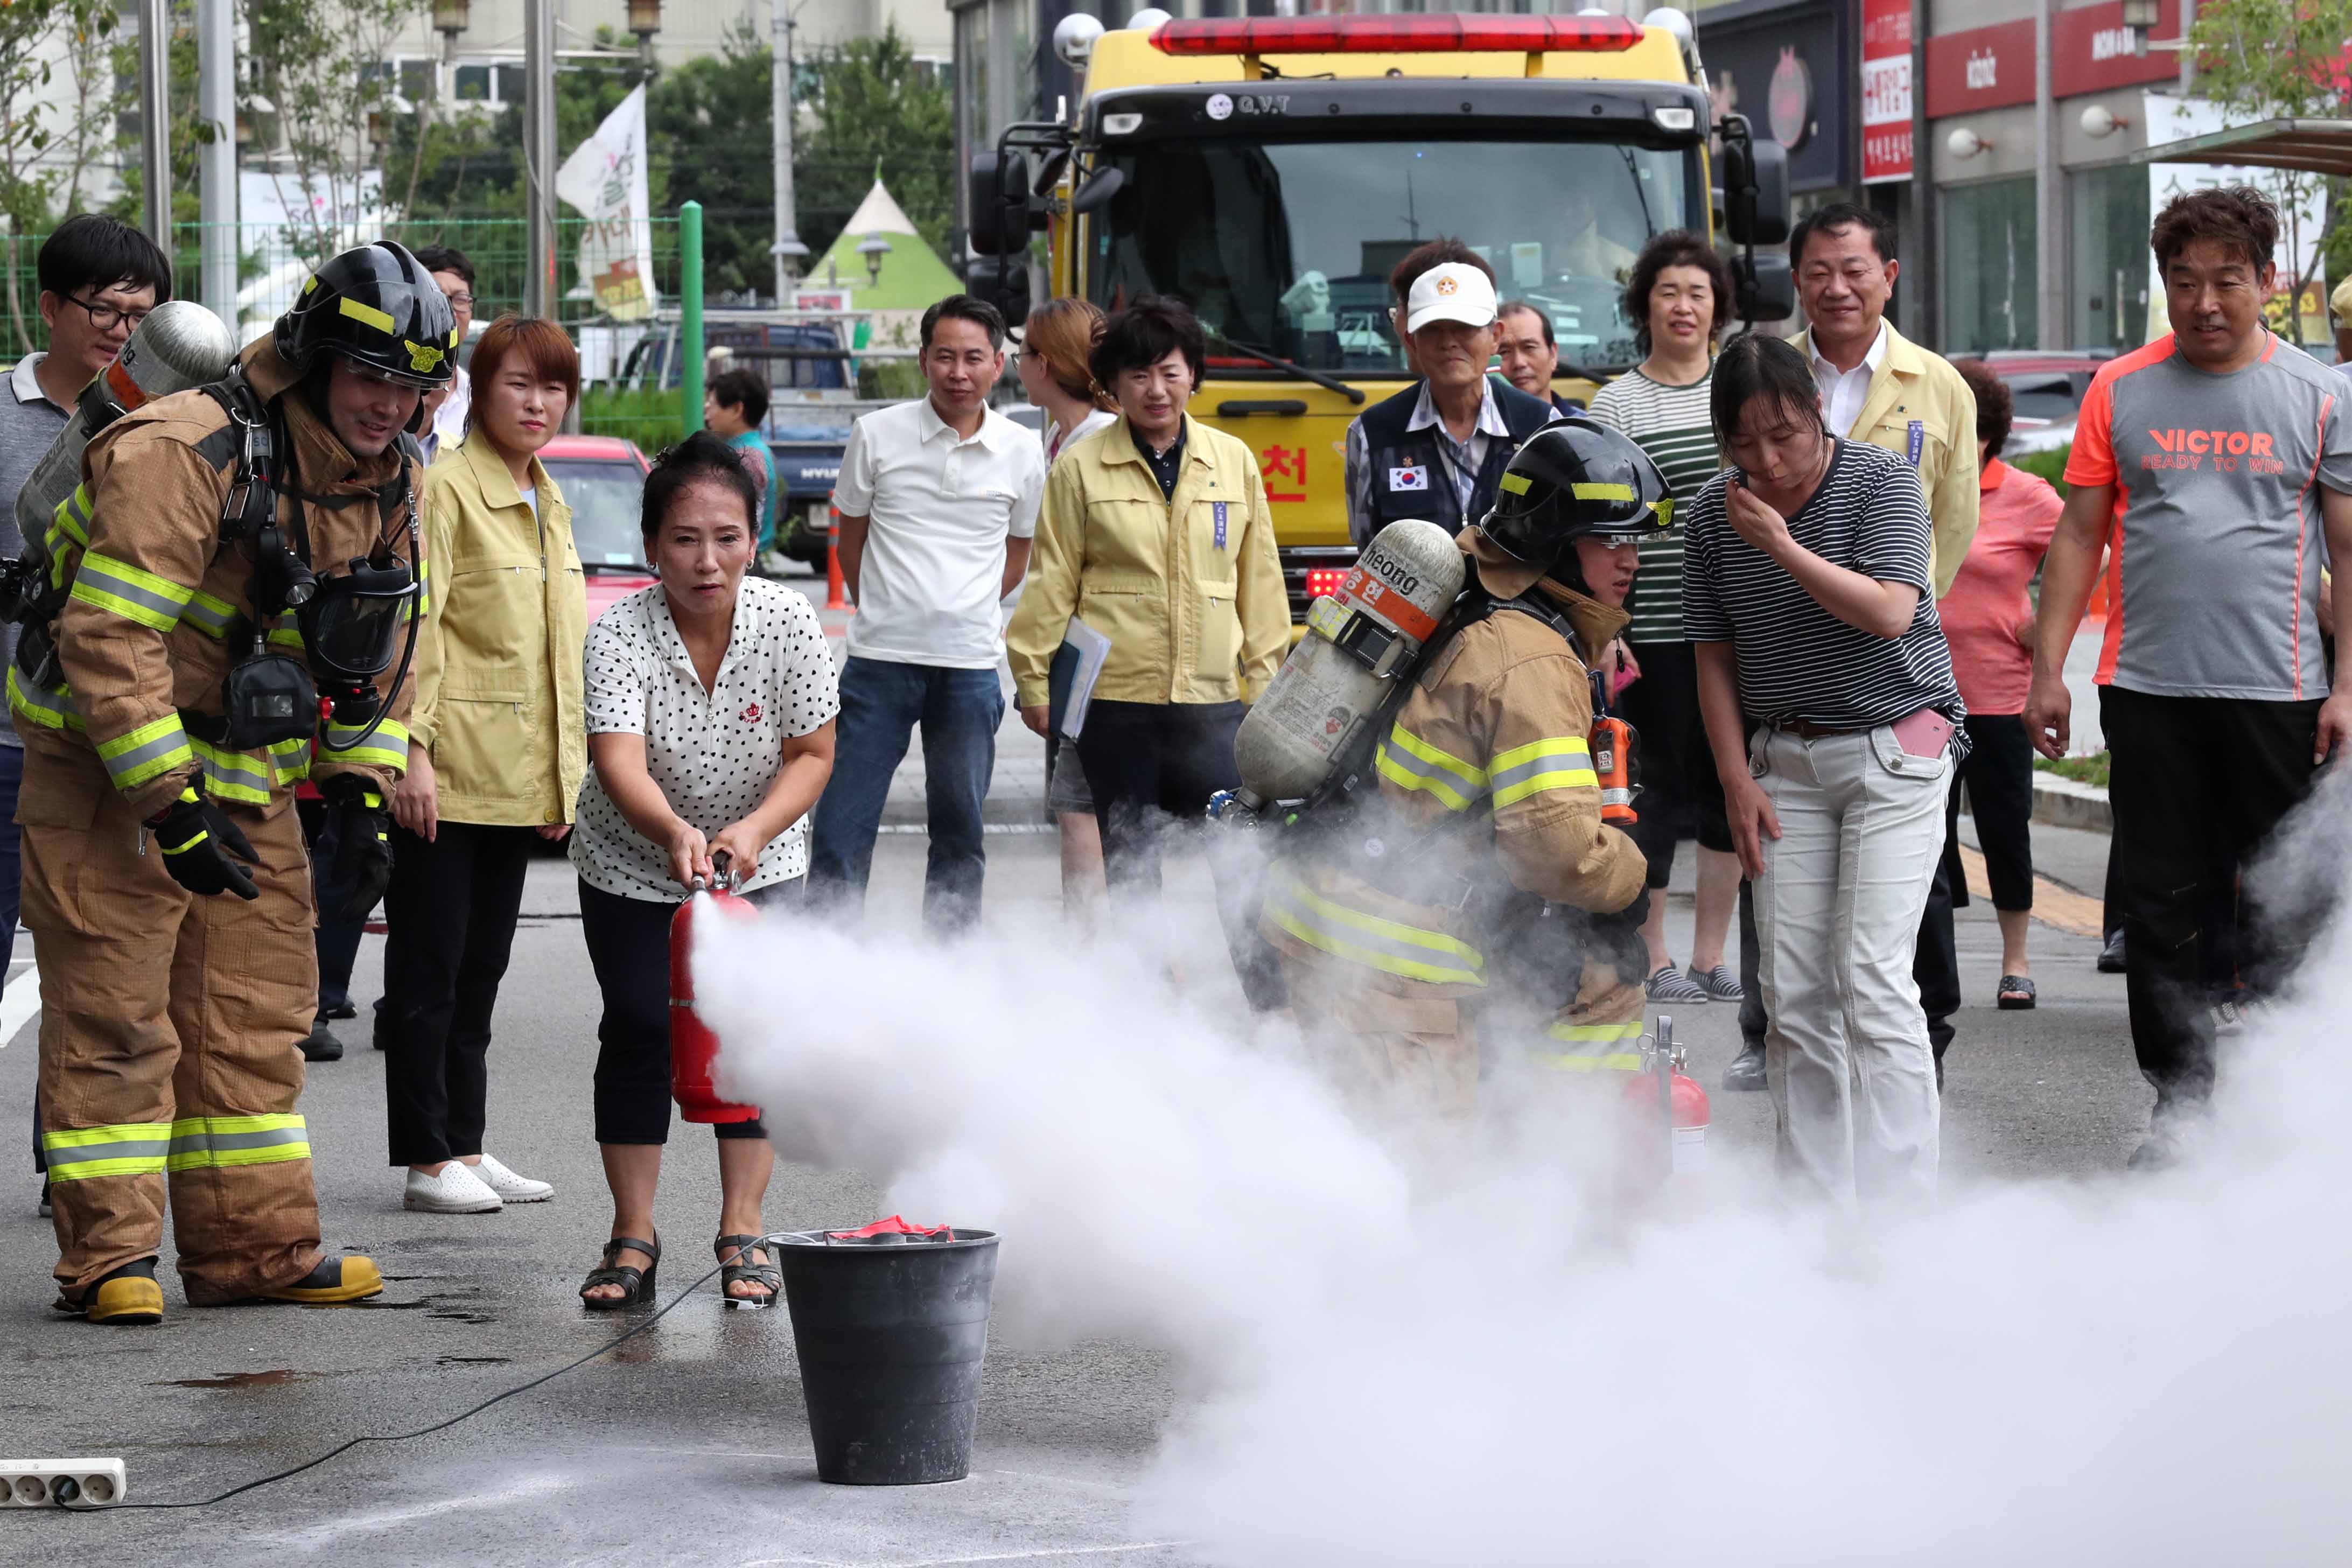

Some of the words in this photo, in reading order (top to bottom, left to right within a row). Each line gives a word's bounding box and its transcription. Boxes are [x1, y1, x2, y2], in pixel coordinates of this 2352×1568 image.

[2148, 429, 2273, 457] VICTOR
[1262, 444, 1307, 503] 천
[2141, 454, 2202, 471] READY
[2213, 457, 2237, 472] TO
[2248, 458, 2284, 475] WIN
